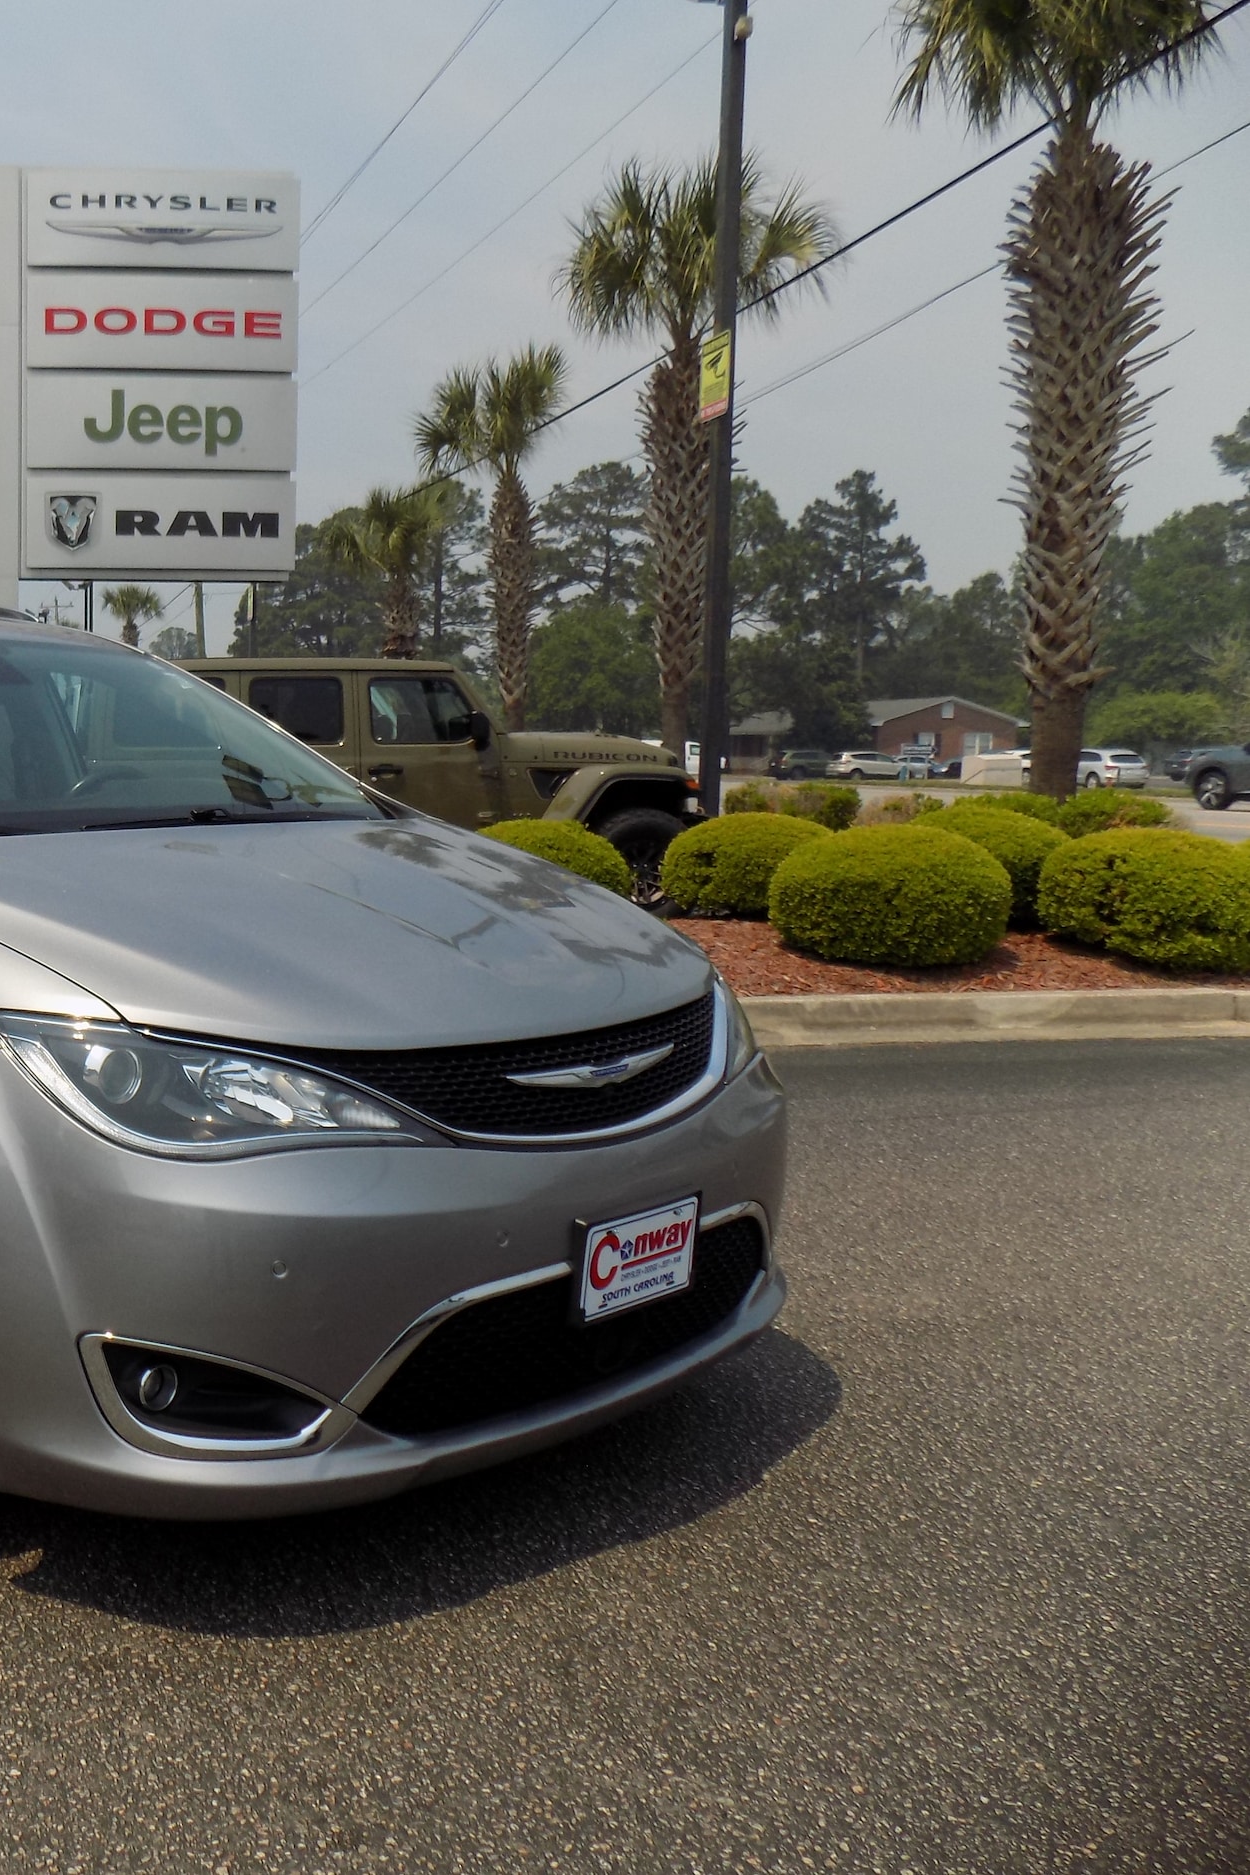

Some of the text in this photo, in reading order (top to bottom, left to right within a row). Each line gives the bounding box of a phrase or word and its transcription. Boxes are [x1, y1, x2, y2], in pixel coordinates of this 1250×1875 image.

[49, 193, 277, 215] CHRYSLER
[44, 306, 282, 339] DODGE
[83, 388, 243, 456] Jeep
[115, 510, 279, 538] RAM
[553, 751, 658, 762] RUBICON
[601, 1271, 675, 1303] SOUTH CAROLINA
